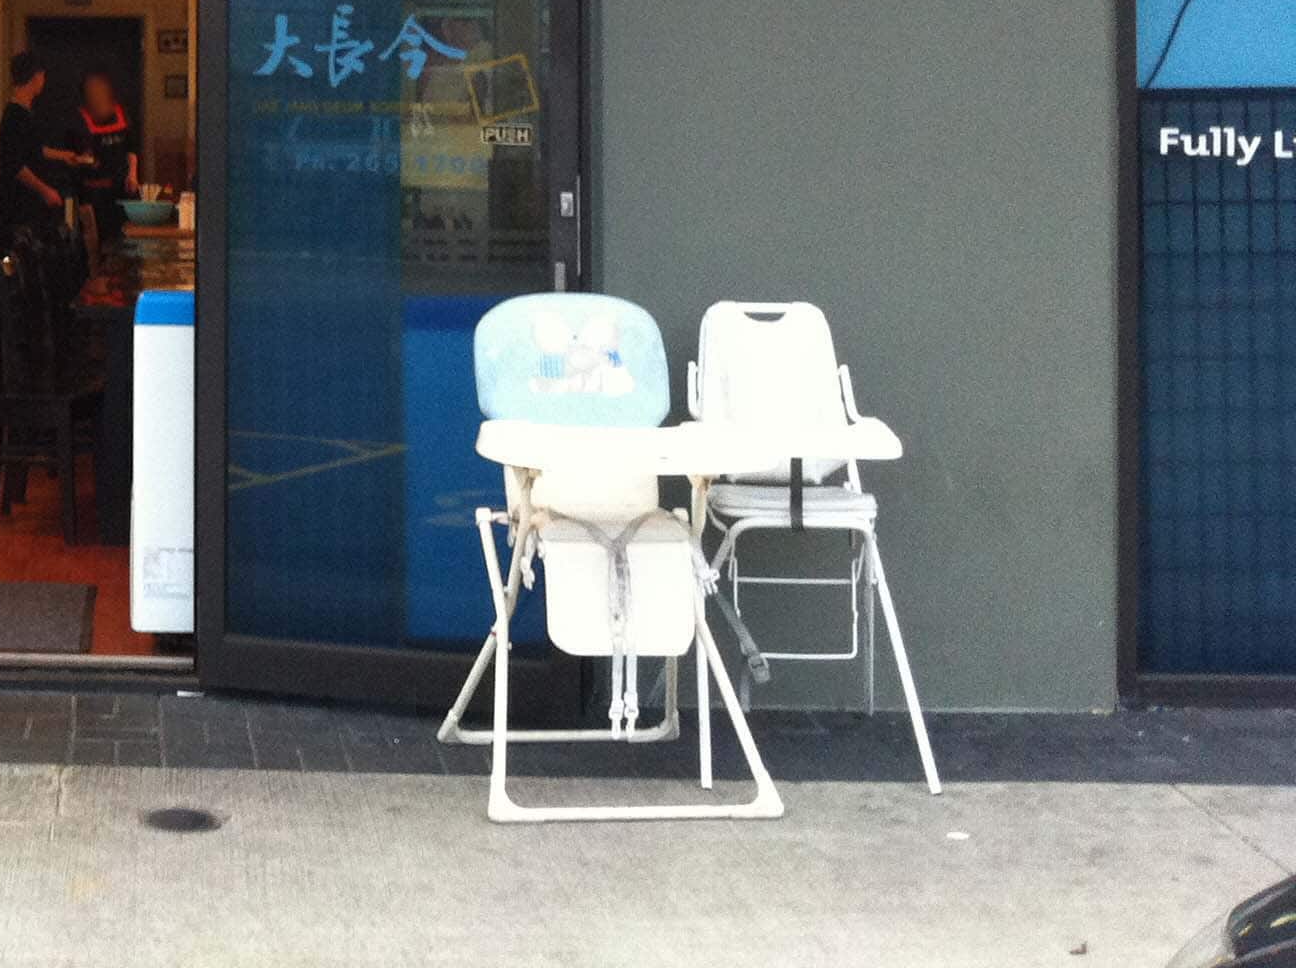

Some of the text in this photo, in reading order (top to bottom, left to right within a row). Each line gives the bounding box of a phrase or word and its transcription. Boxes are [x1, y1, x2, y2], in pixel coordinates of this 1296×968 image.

[253, 4, 467, 88] 大長今
[484, 127, 531, 144] PUSH
[1159, 126, 1261, 167] Fully
